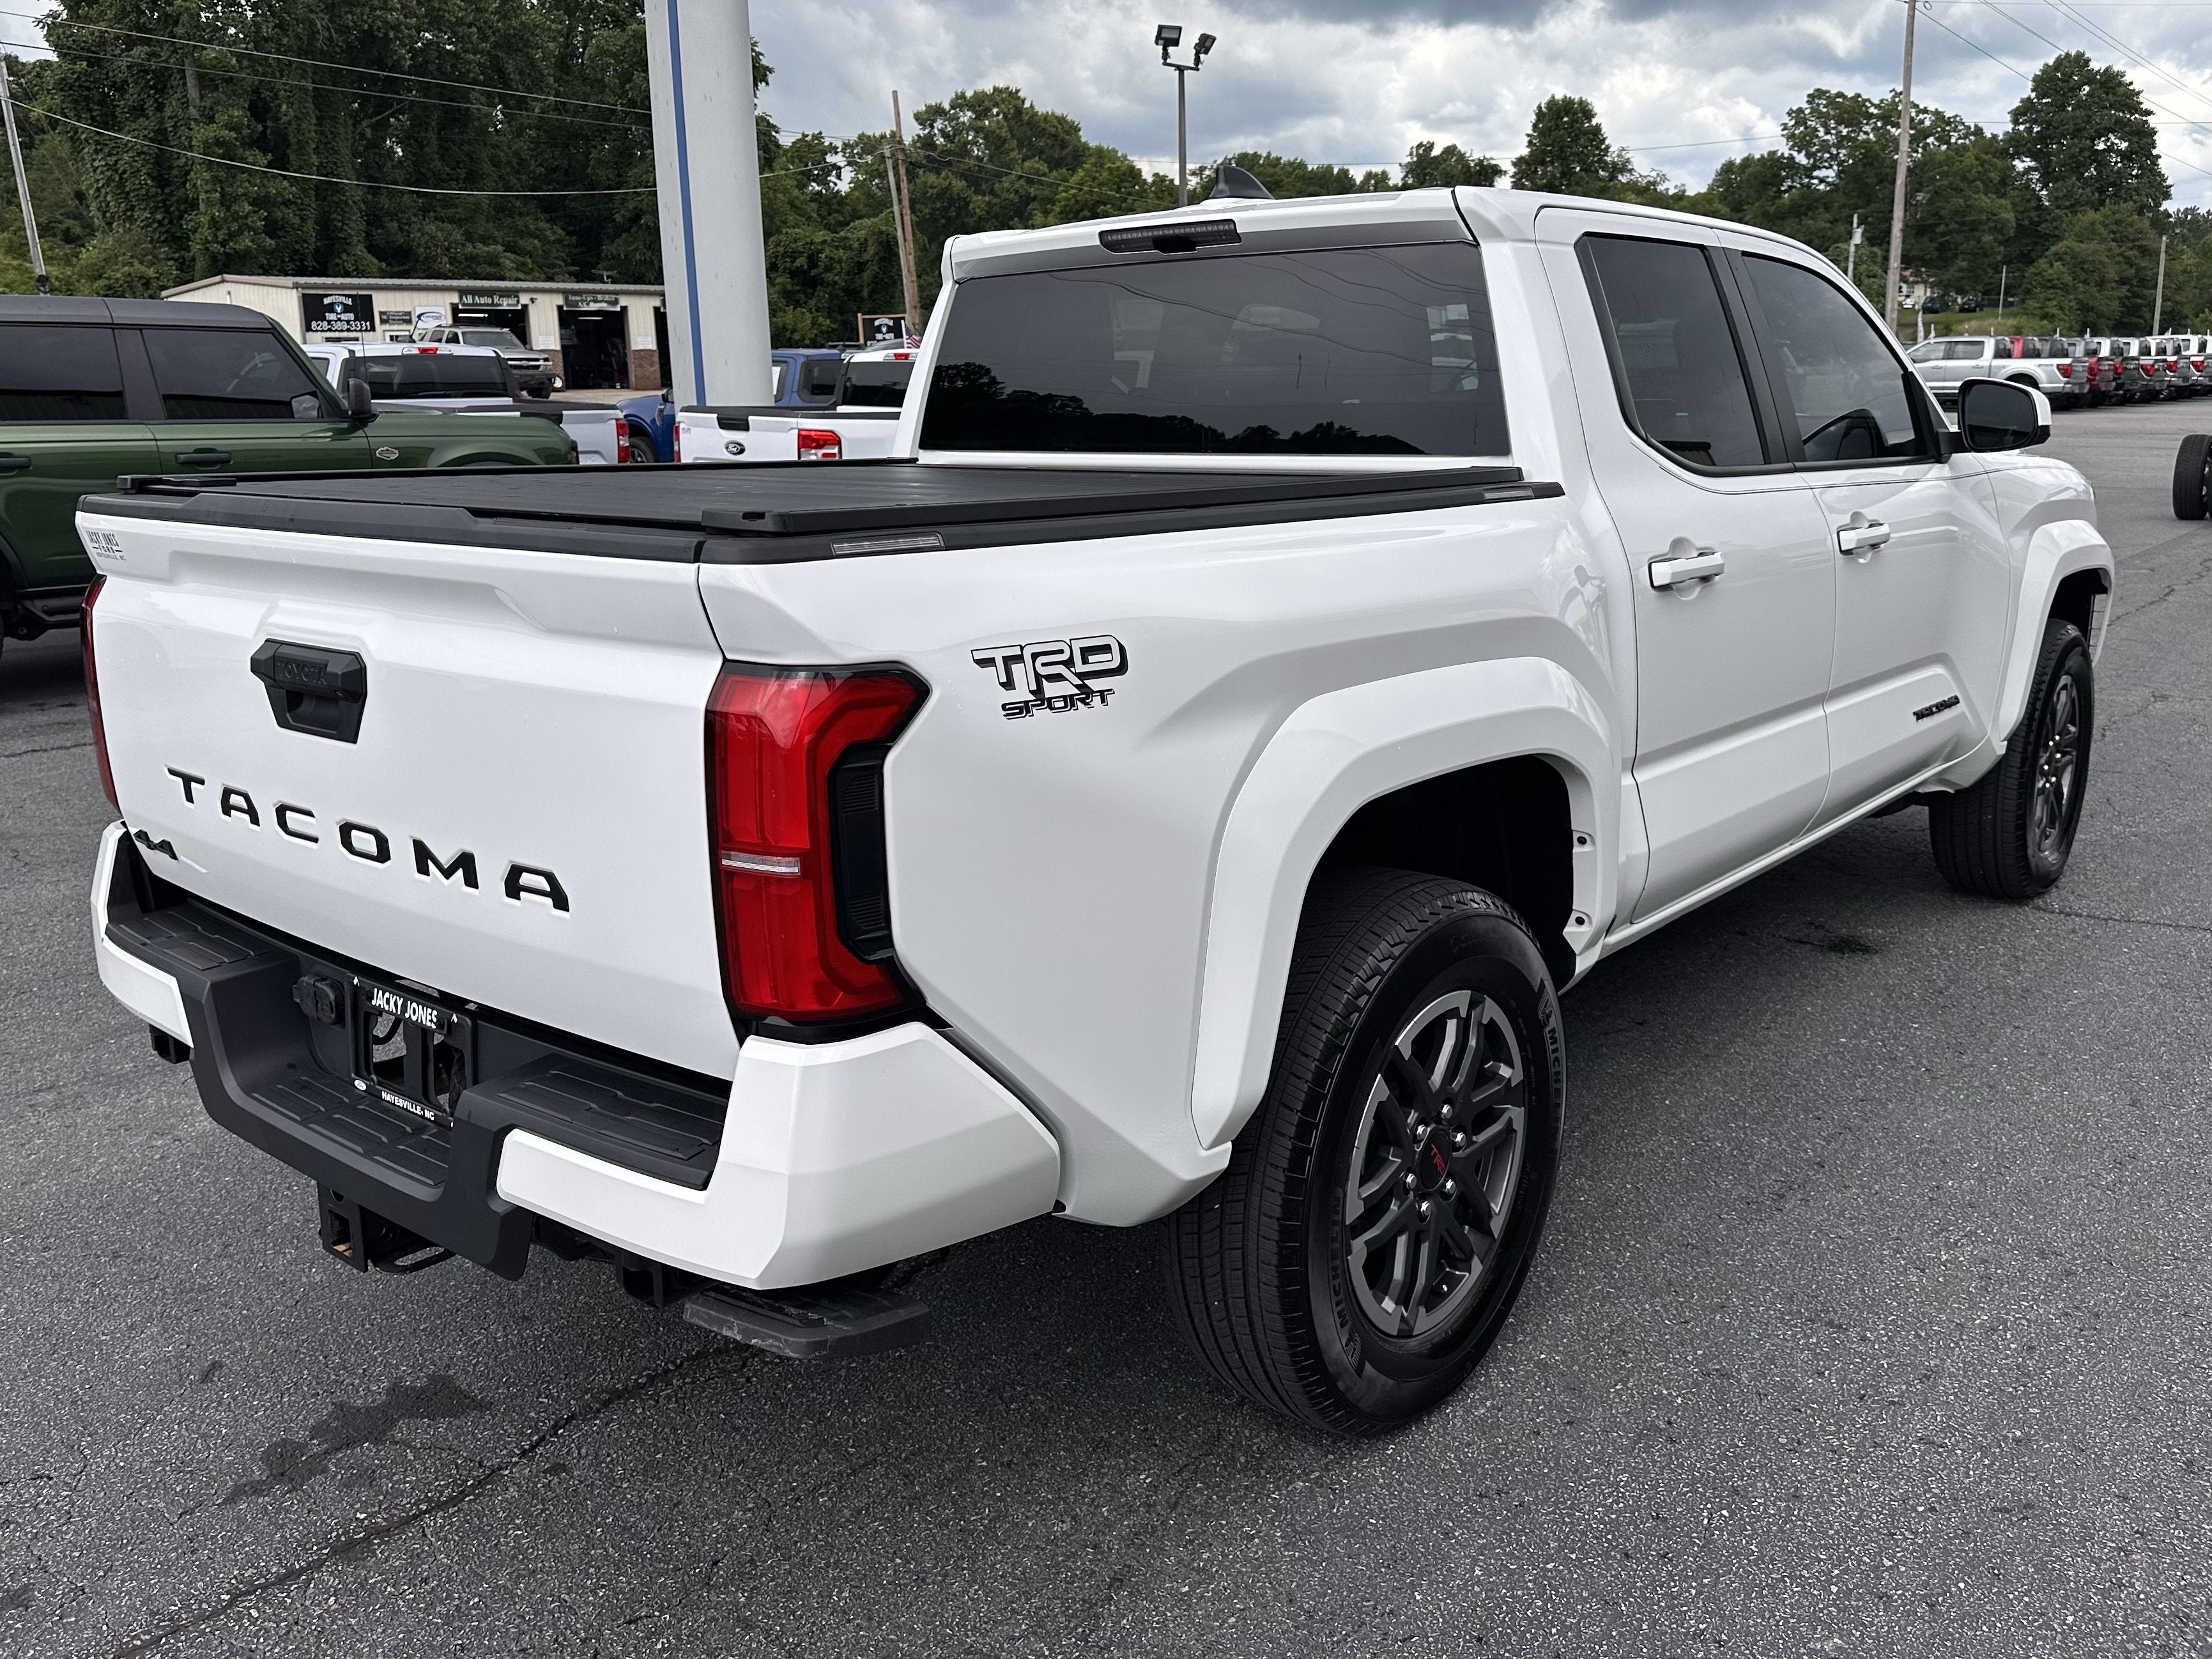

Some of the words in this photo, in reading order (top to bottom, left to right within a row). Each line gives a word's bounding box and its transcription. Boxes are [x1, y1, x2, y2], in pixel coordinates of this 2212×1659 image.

[461, 295, 472, 304] All
[474, 295, 492, 304] Auto
[493, 295, 518, 306] Repair
[275, 661, 327, 685] TOYOTA
[971, 635, 1128, 699] TRD
[1001, 688, 1115, 720] SPORT
[166, 766, 569, 912] TACOMA
[372, 987, 403, 1015] JACKY
[405, 1000, 438, 1029] JONES
[424, 1109, 435, 1121] NC
